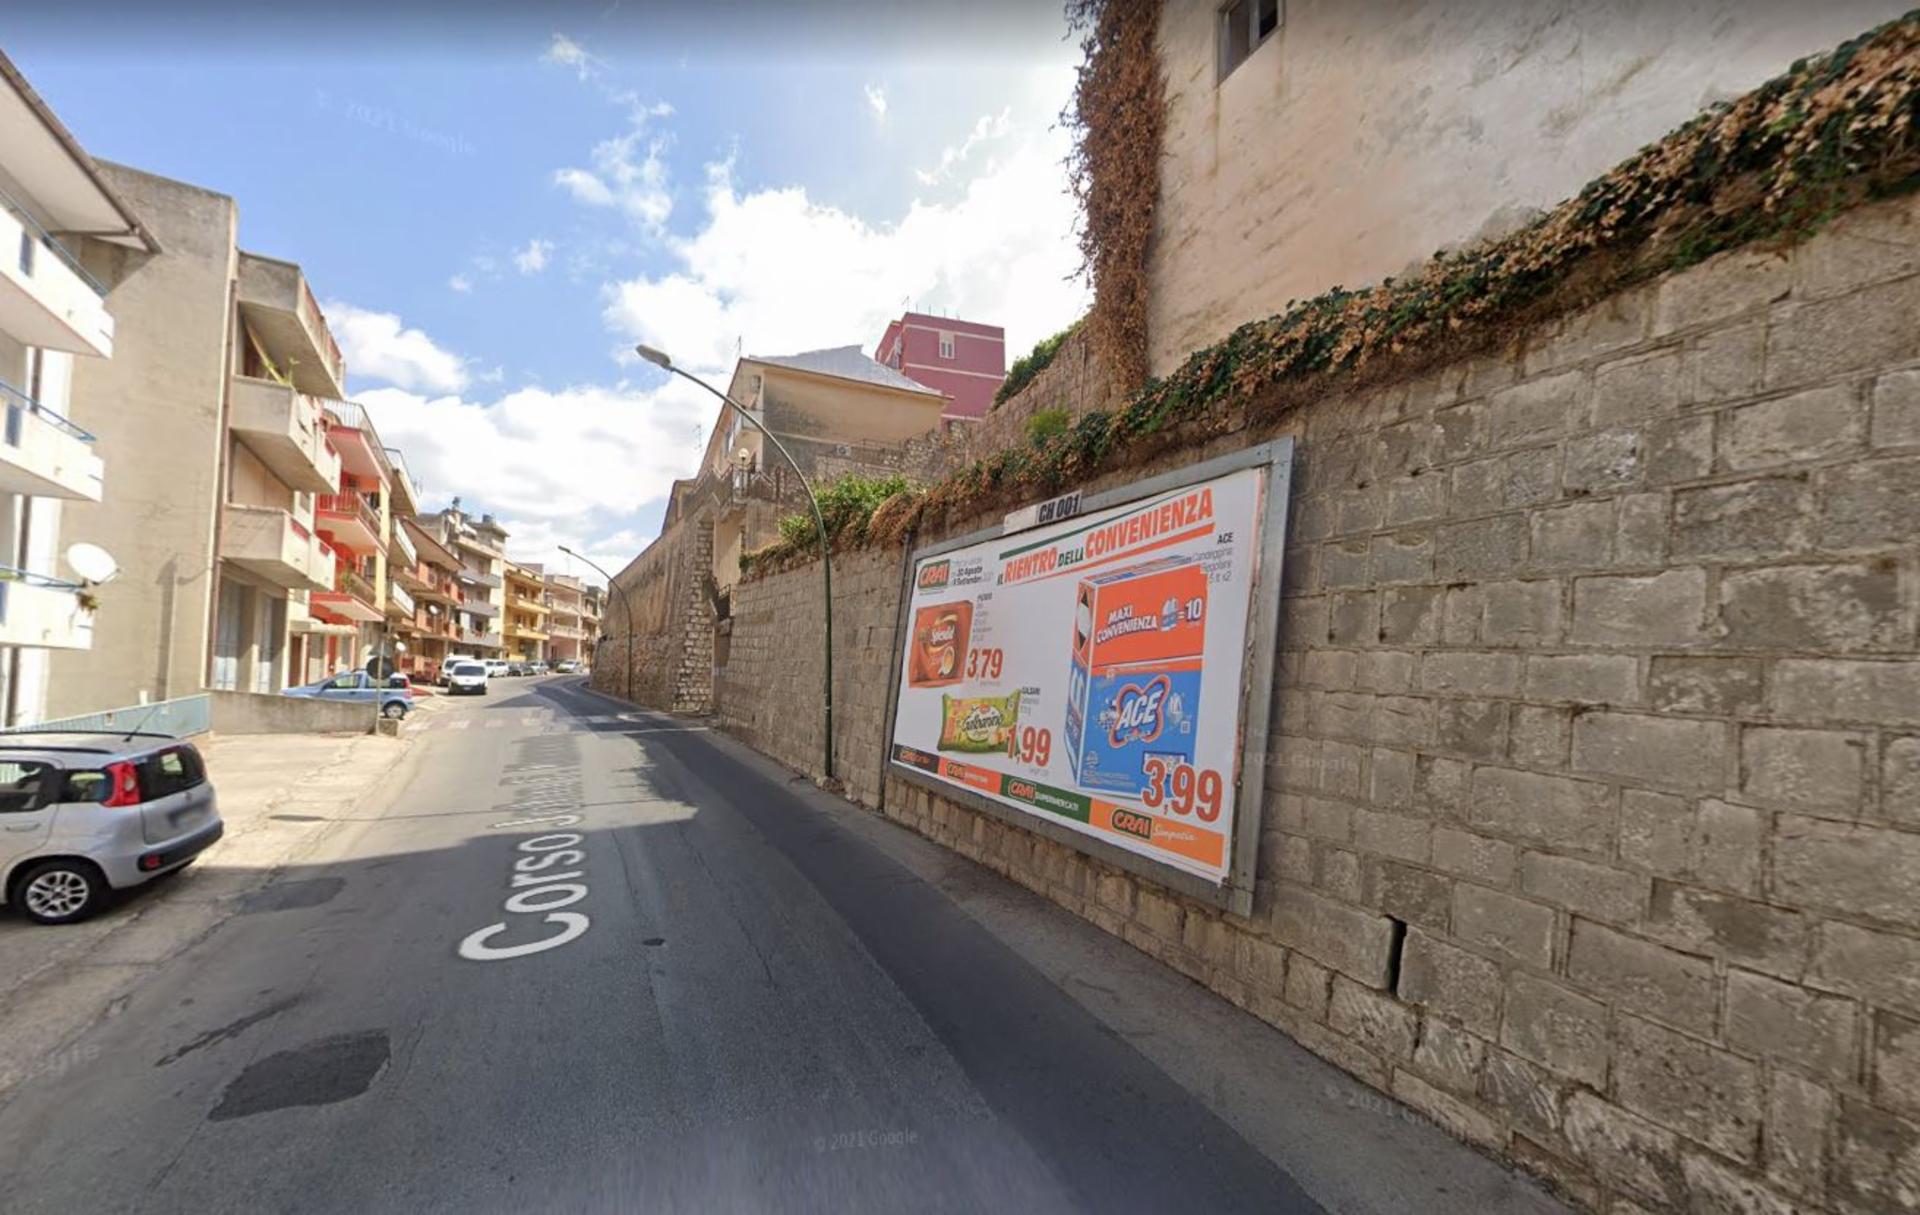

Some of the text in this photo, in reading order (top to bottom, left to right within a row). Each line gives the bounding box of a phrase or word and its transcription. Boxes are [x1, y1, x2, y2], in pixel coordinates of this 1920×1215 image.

[1039, 495, 1080, 522] CH 001
[1005, 547, 1057, 583] RIENTRO
[1058, 547, 1084, 567] DELLA
[1085, 488, 1214, 560] CONVENIENZA
[1217, 532, 1233, 544] ACE
[919, 563, 949, 587] CRAI
[1108, 605, 1133, 625] MAXI
[1096, 616, 1158, 644] CONVENIENZA
[967, 648, 1003, 682] 3,79
[1117, 690, 1164, 730] ACE
[1007, 726, 1051, 767] 1,99
[1009, 782, 1035, 801] CRAI
[1142, 758, 1222, 823] 3,99
[1114, 811, 1149, 836] CRAI
